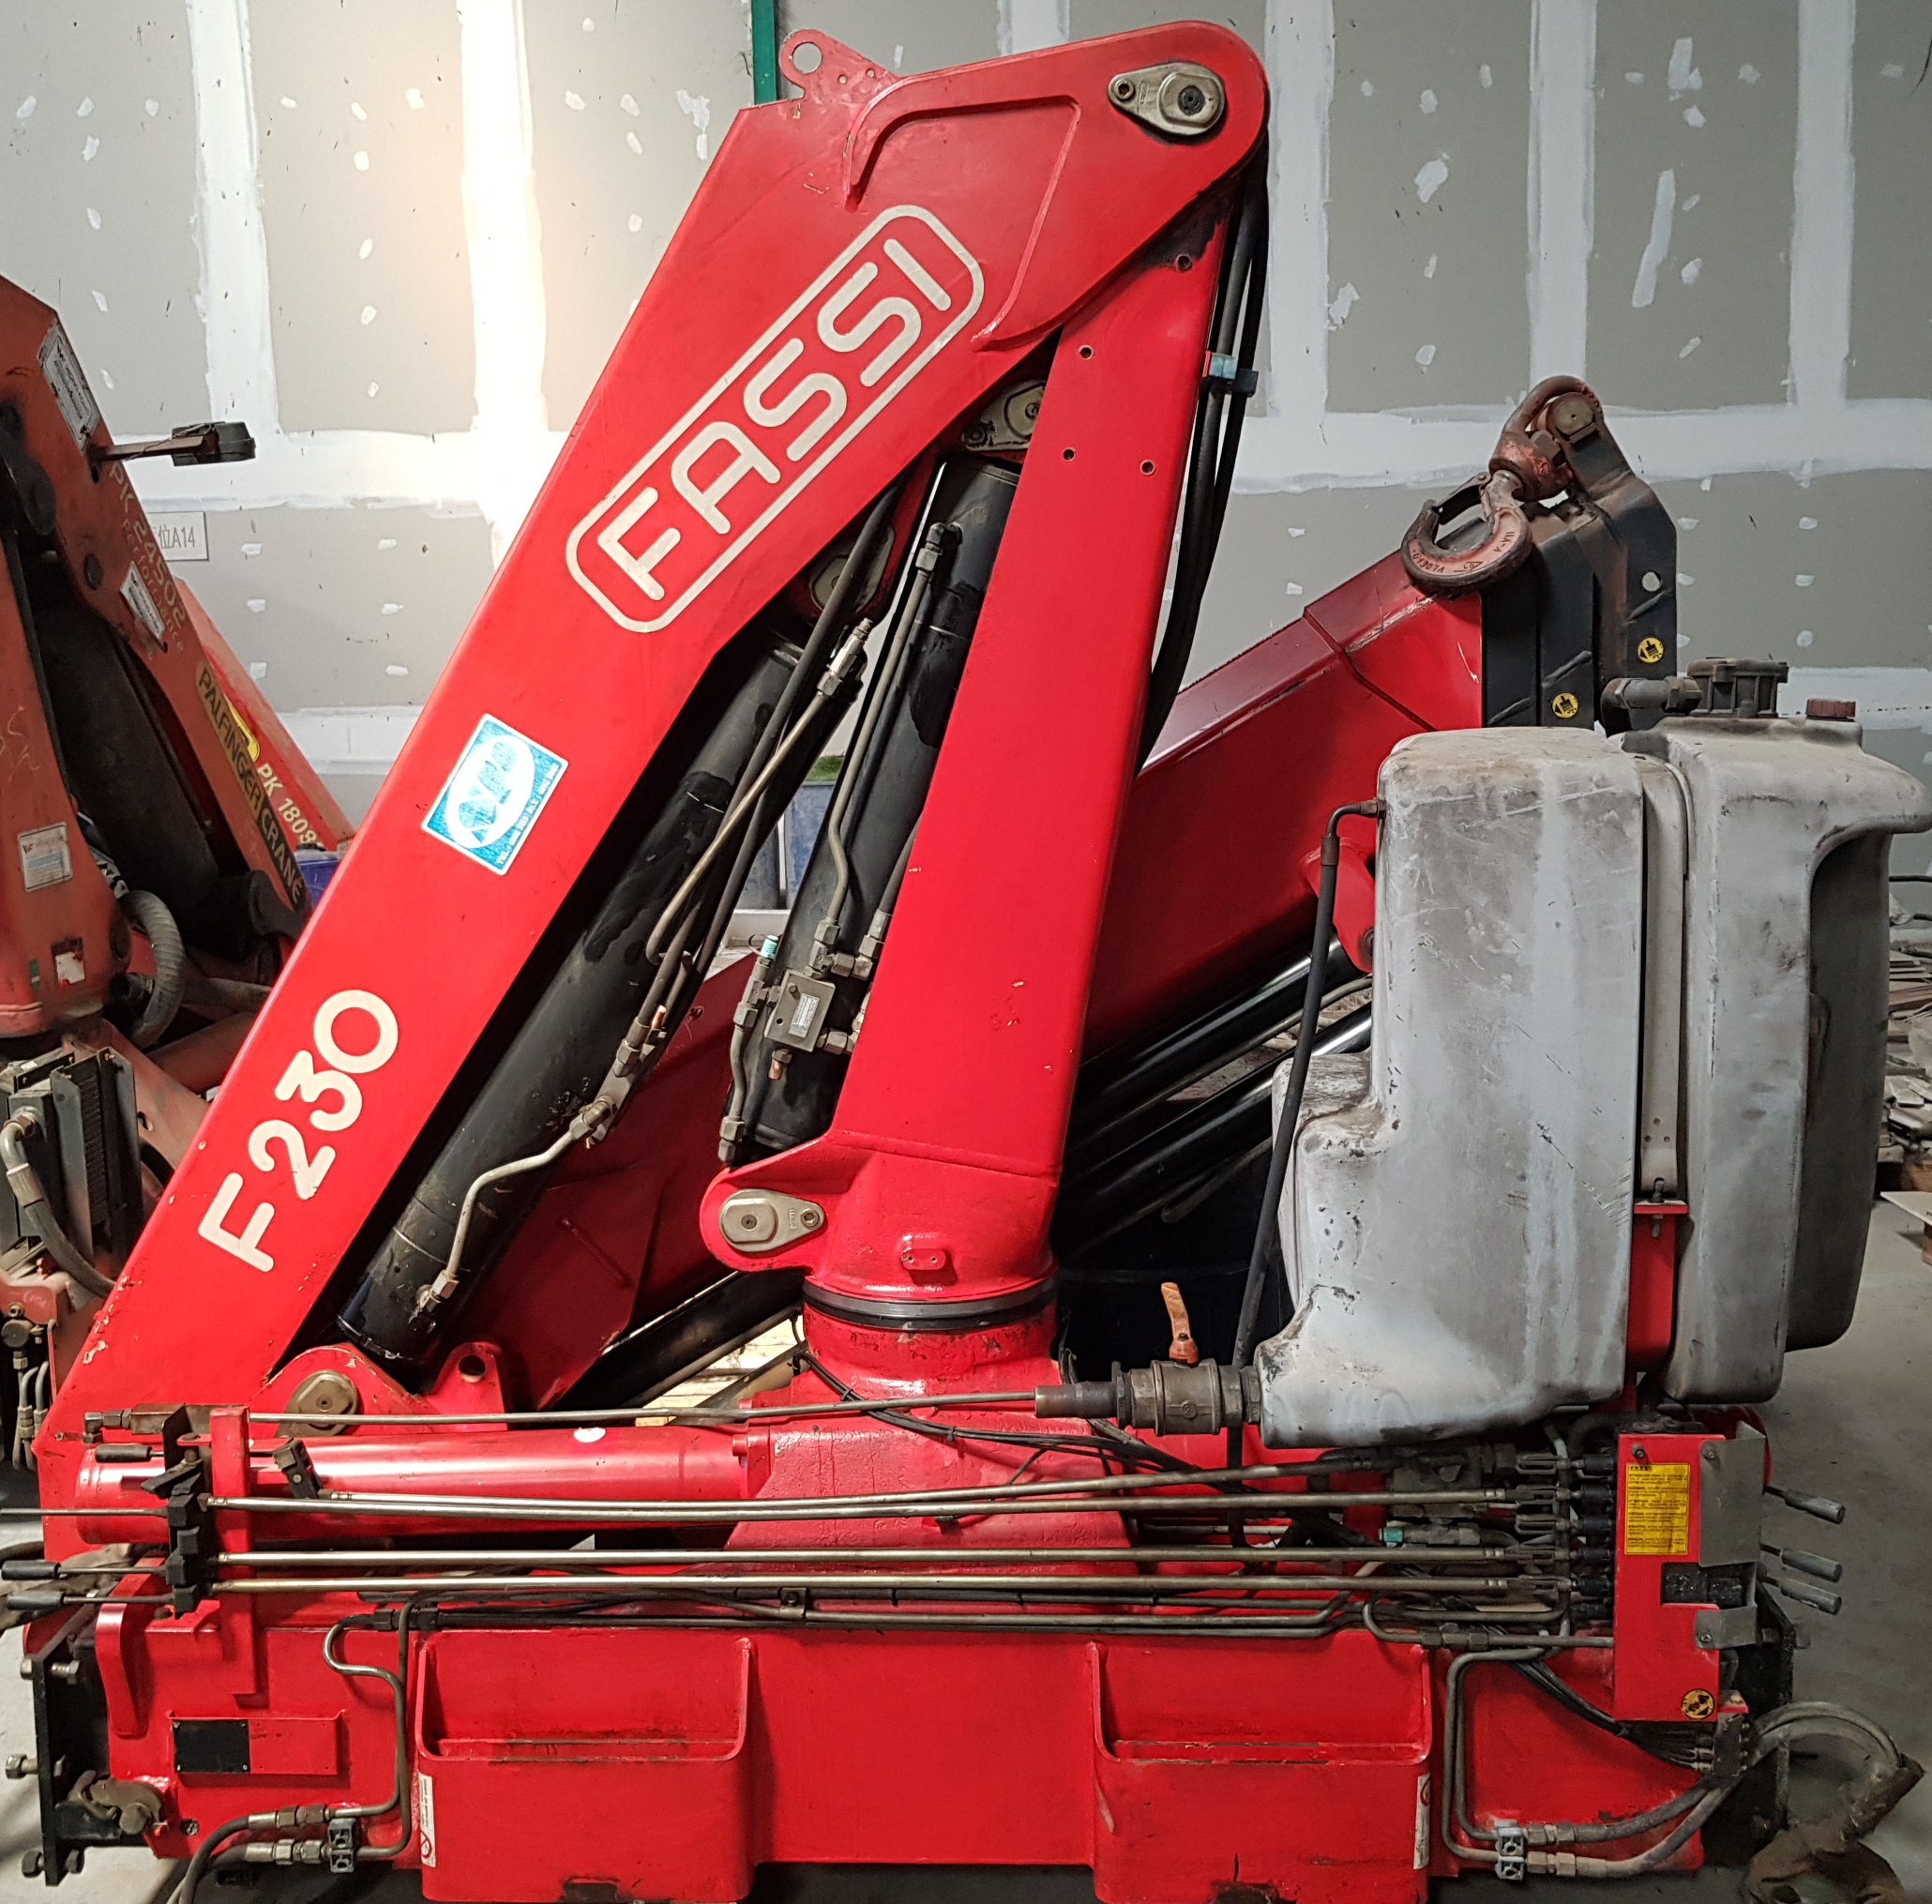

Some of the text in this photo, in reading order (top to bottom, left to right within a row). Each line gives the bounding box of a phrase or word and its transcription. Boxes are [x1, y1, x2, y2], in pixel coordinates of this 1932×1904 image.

[109, 461, 134, 513] PK
[597, 239, 951, 600] FASSI
[199, 667, 302, 904] PALFINGER CRANE
[257, 763, 325, 847] PK 1809
